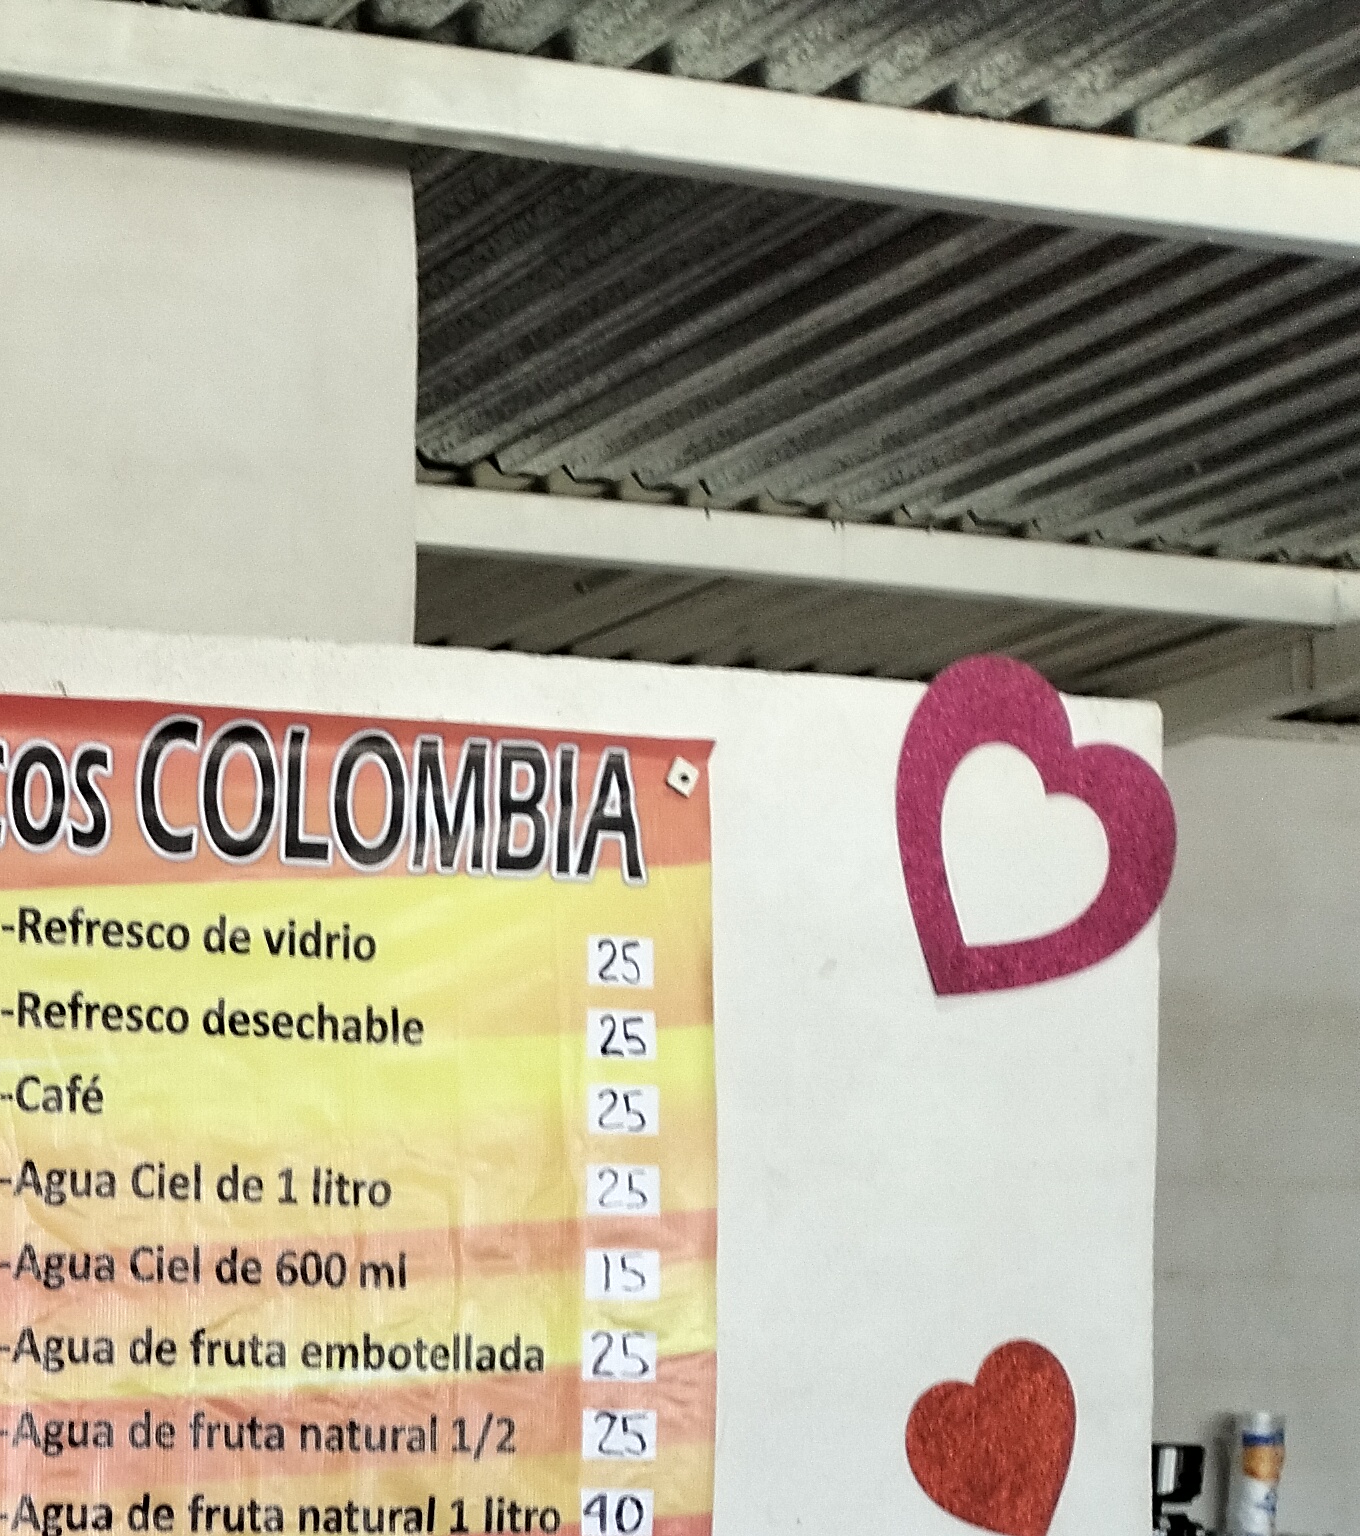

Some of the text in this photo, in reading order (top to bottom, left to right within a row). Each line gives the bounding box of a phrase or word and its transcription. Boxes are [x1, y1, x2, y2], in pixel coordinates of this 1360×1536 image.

[136, 716, 647, 884] COLOMBIA
[203, 915, 251, 956] de
[264, 919, 376, 962] vidrio
[598, 940, 642, 981] 25
[202, 998, 425, 1047] desechable
[600, 1017, 647, 1056] 25
[598, 1090, 647, 1131] 25
[131, 1162, 201, 1202] Ciel
[216, 1166, 263, 1203] de
[278, 1169, 298, 1204] 1
[312, 1168, 392, 1208] litro
[596, 1169, 647, 1210] 25
[129, 1245, 200, 1284] Ciel
[215, 1248, 262, 1285] de
[277, 1253, 347, 1288] 600
[360, 1253, 407, 1288] ml
[602, 1255, 645, 1293] 15
[129, 1329, 176, 1367] de
[189, 1329, 286, 1370] fruta
[300, 1333, 545, 1374] embotellada
[591, 1333, 647, 1377] 25
[126, 1495, 175, 1534] de
[188, 1494, 283, 1535] fruta
[298, 1498, 436, 1535] natural
[450, 1498, 470, 1534] 1
[484, 1495, 560, 1535] litro
